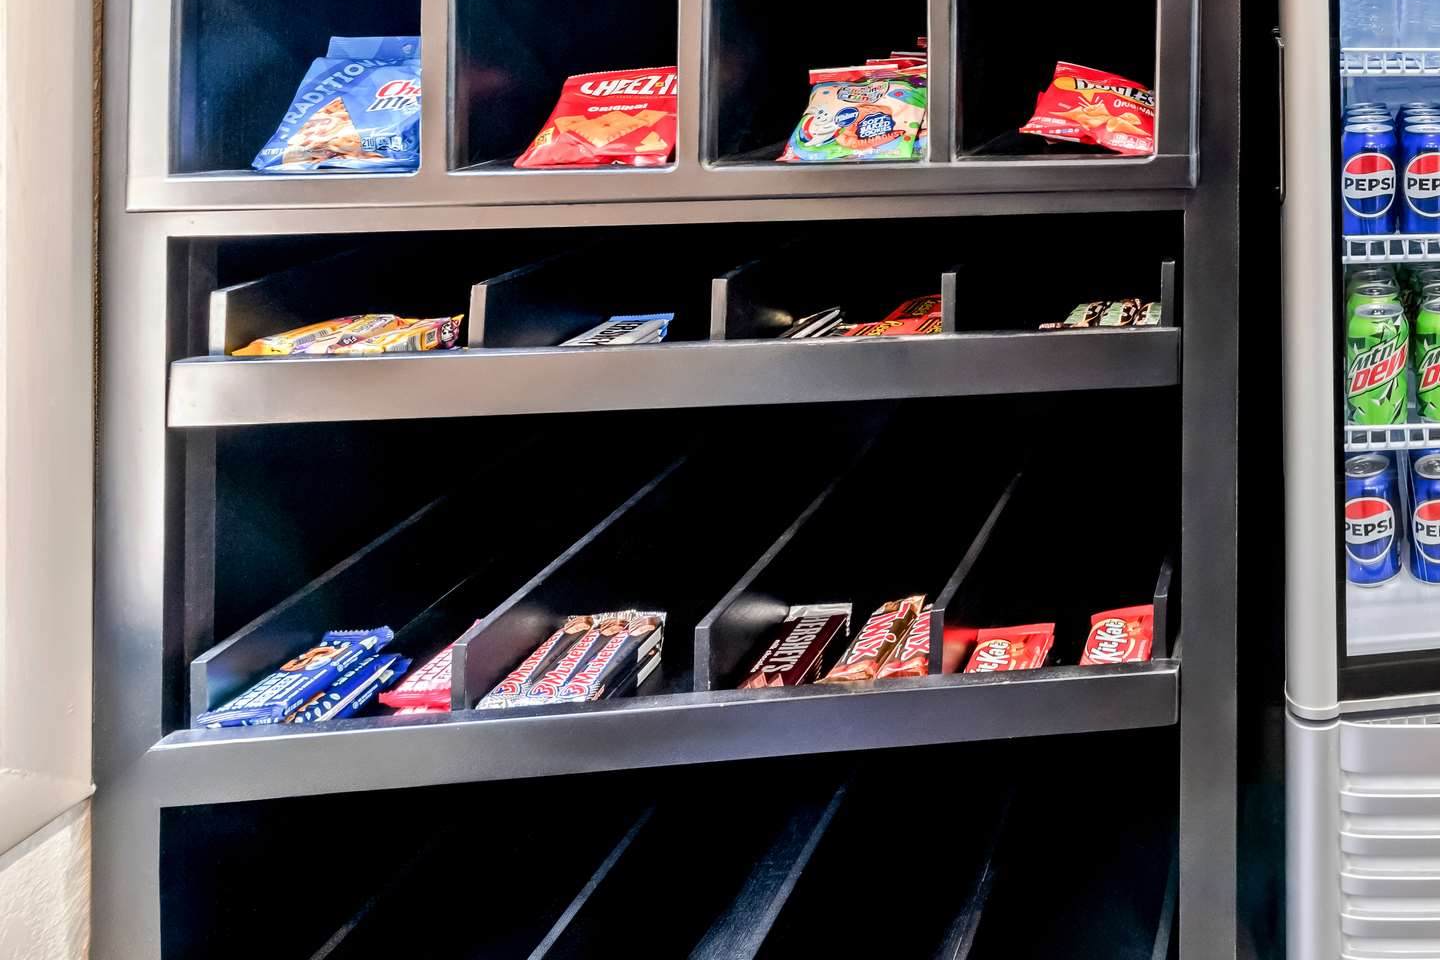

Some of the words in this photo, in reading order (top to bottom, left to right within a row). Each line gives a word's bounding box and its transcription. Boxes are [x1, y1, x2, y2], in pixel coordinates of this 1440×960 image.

[1345, 177, 1394, 191] PEPSI
[531, 683, 555, 696] 3
[562, 683, 585, 696] 3
